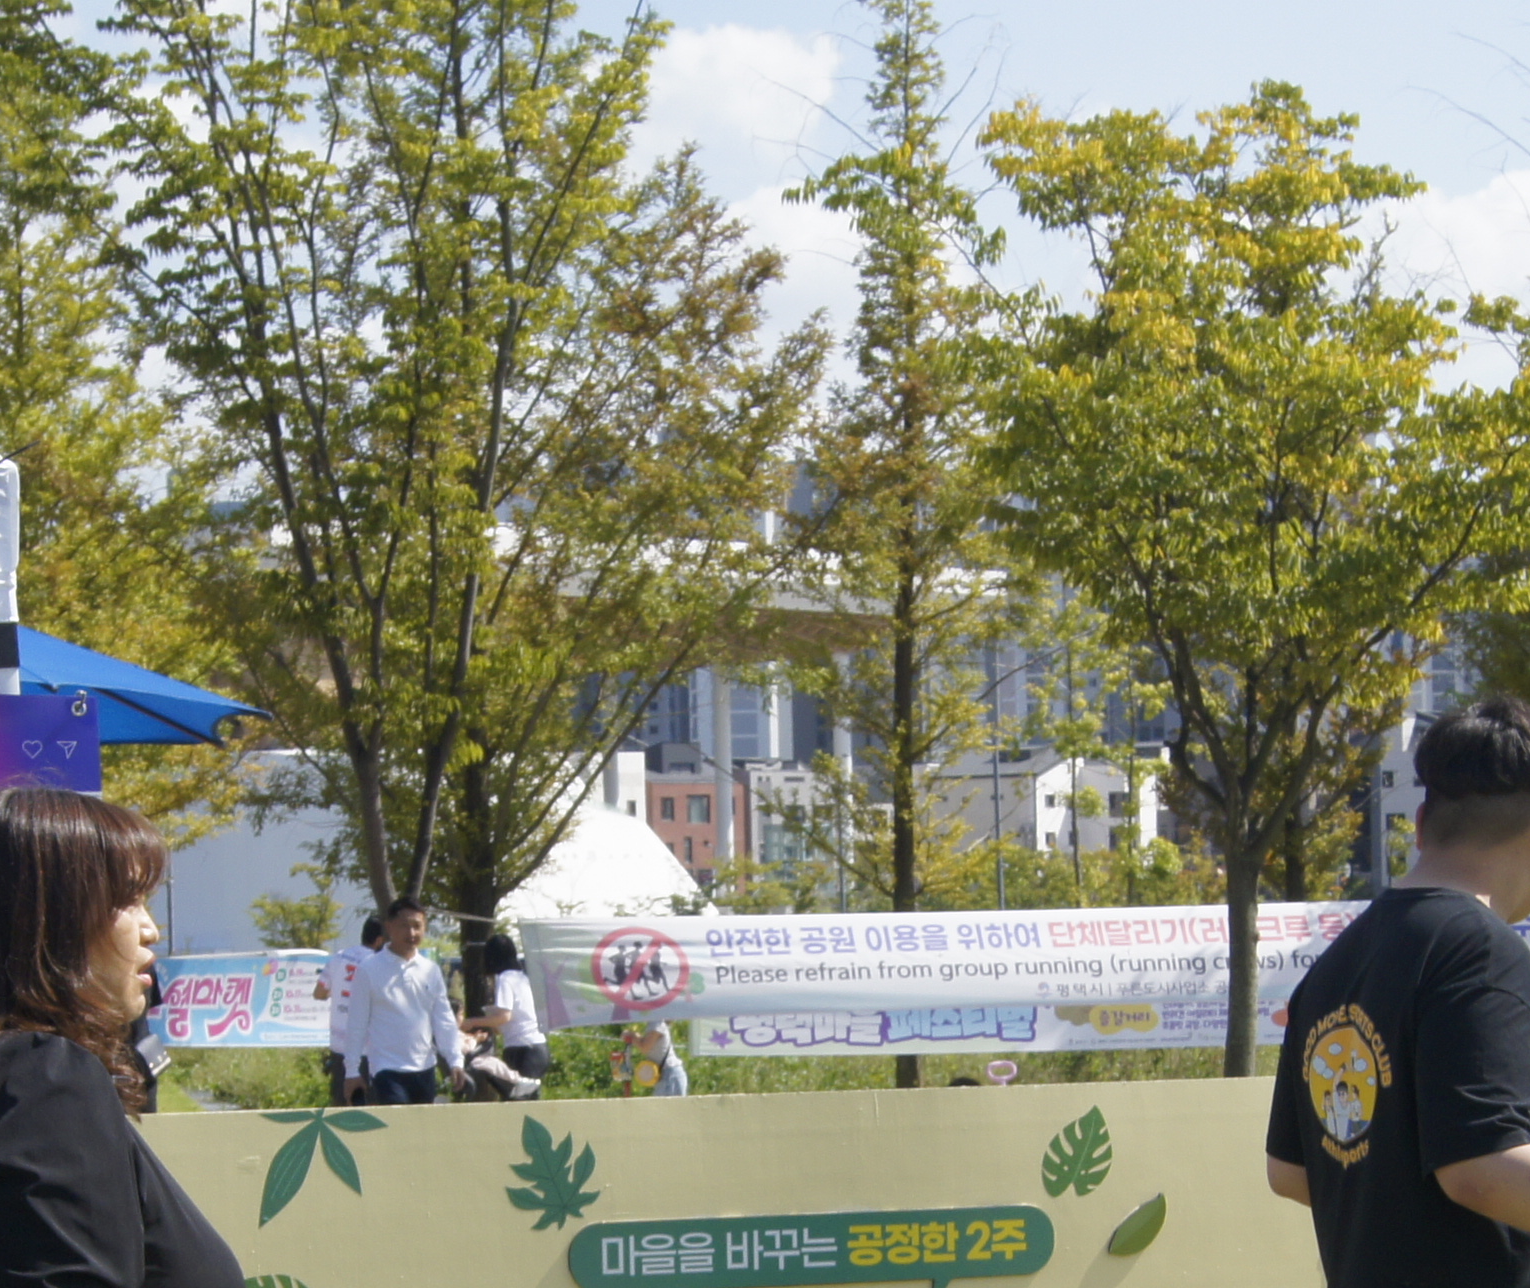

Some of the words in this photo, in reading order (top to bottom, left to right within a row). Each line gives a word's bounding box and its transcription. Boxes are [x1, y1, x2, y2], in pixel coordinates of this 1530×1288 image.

[705, 927, 792, 958] 안전한
[799, 925, 857, 955] 공원
[865, 923, 949, 952] 이용을
[957, 921, 1042, 950] 위하여
[1047, 914, 1313, 947] 단체달리기(러크루
[715, 964, 788, 984] Please
[795, 961, 872, 981] refrain
[878, 960, 933, 979] from
[939, 961, 1009, 982] group
[1015, 957, 1104, 977] running
[1110, 953, 1207, 976] (running
[1116, 982, 1209, 996] 푸른도시사업소
[148, 977, 254, 1039] 셜마켓
[886, 1006, 1038, 1043] 페스티벌
[1371, 1032, 1393, 1088] CLUB
[601, 1231, 715, 1277] 마을을
[726, 1227, 839, 1270] 바꾸는
[847, 1221, 958, 1267] 공정한
[965, 1219, 1028, 1262] 2주
